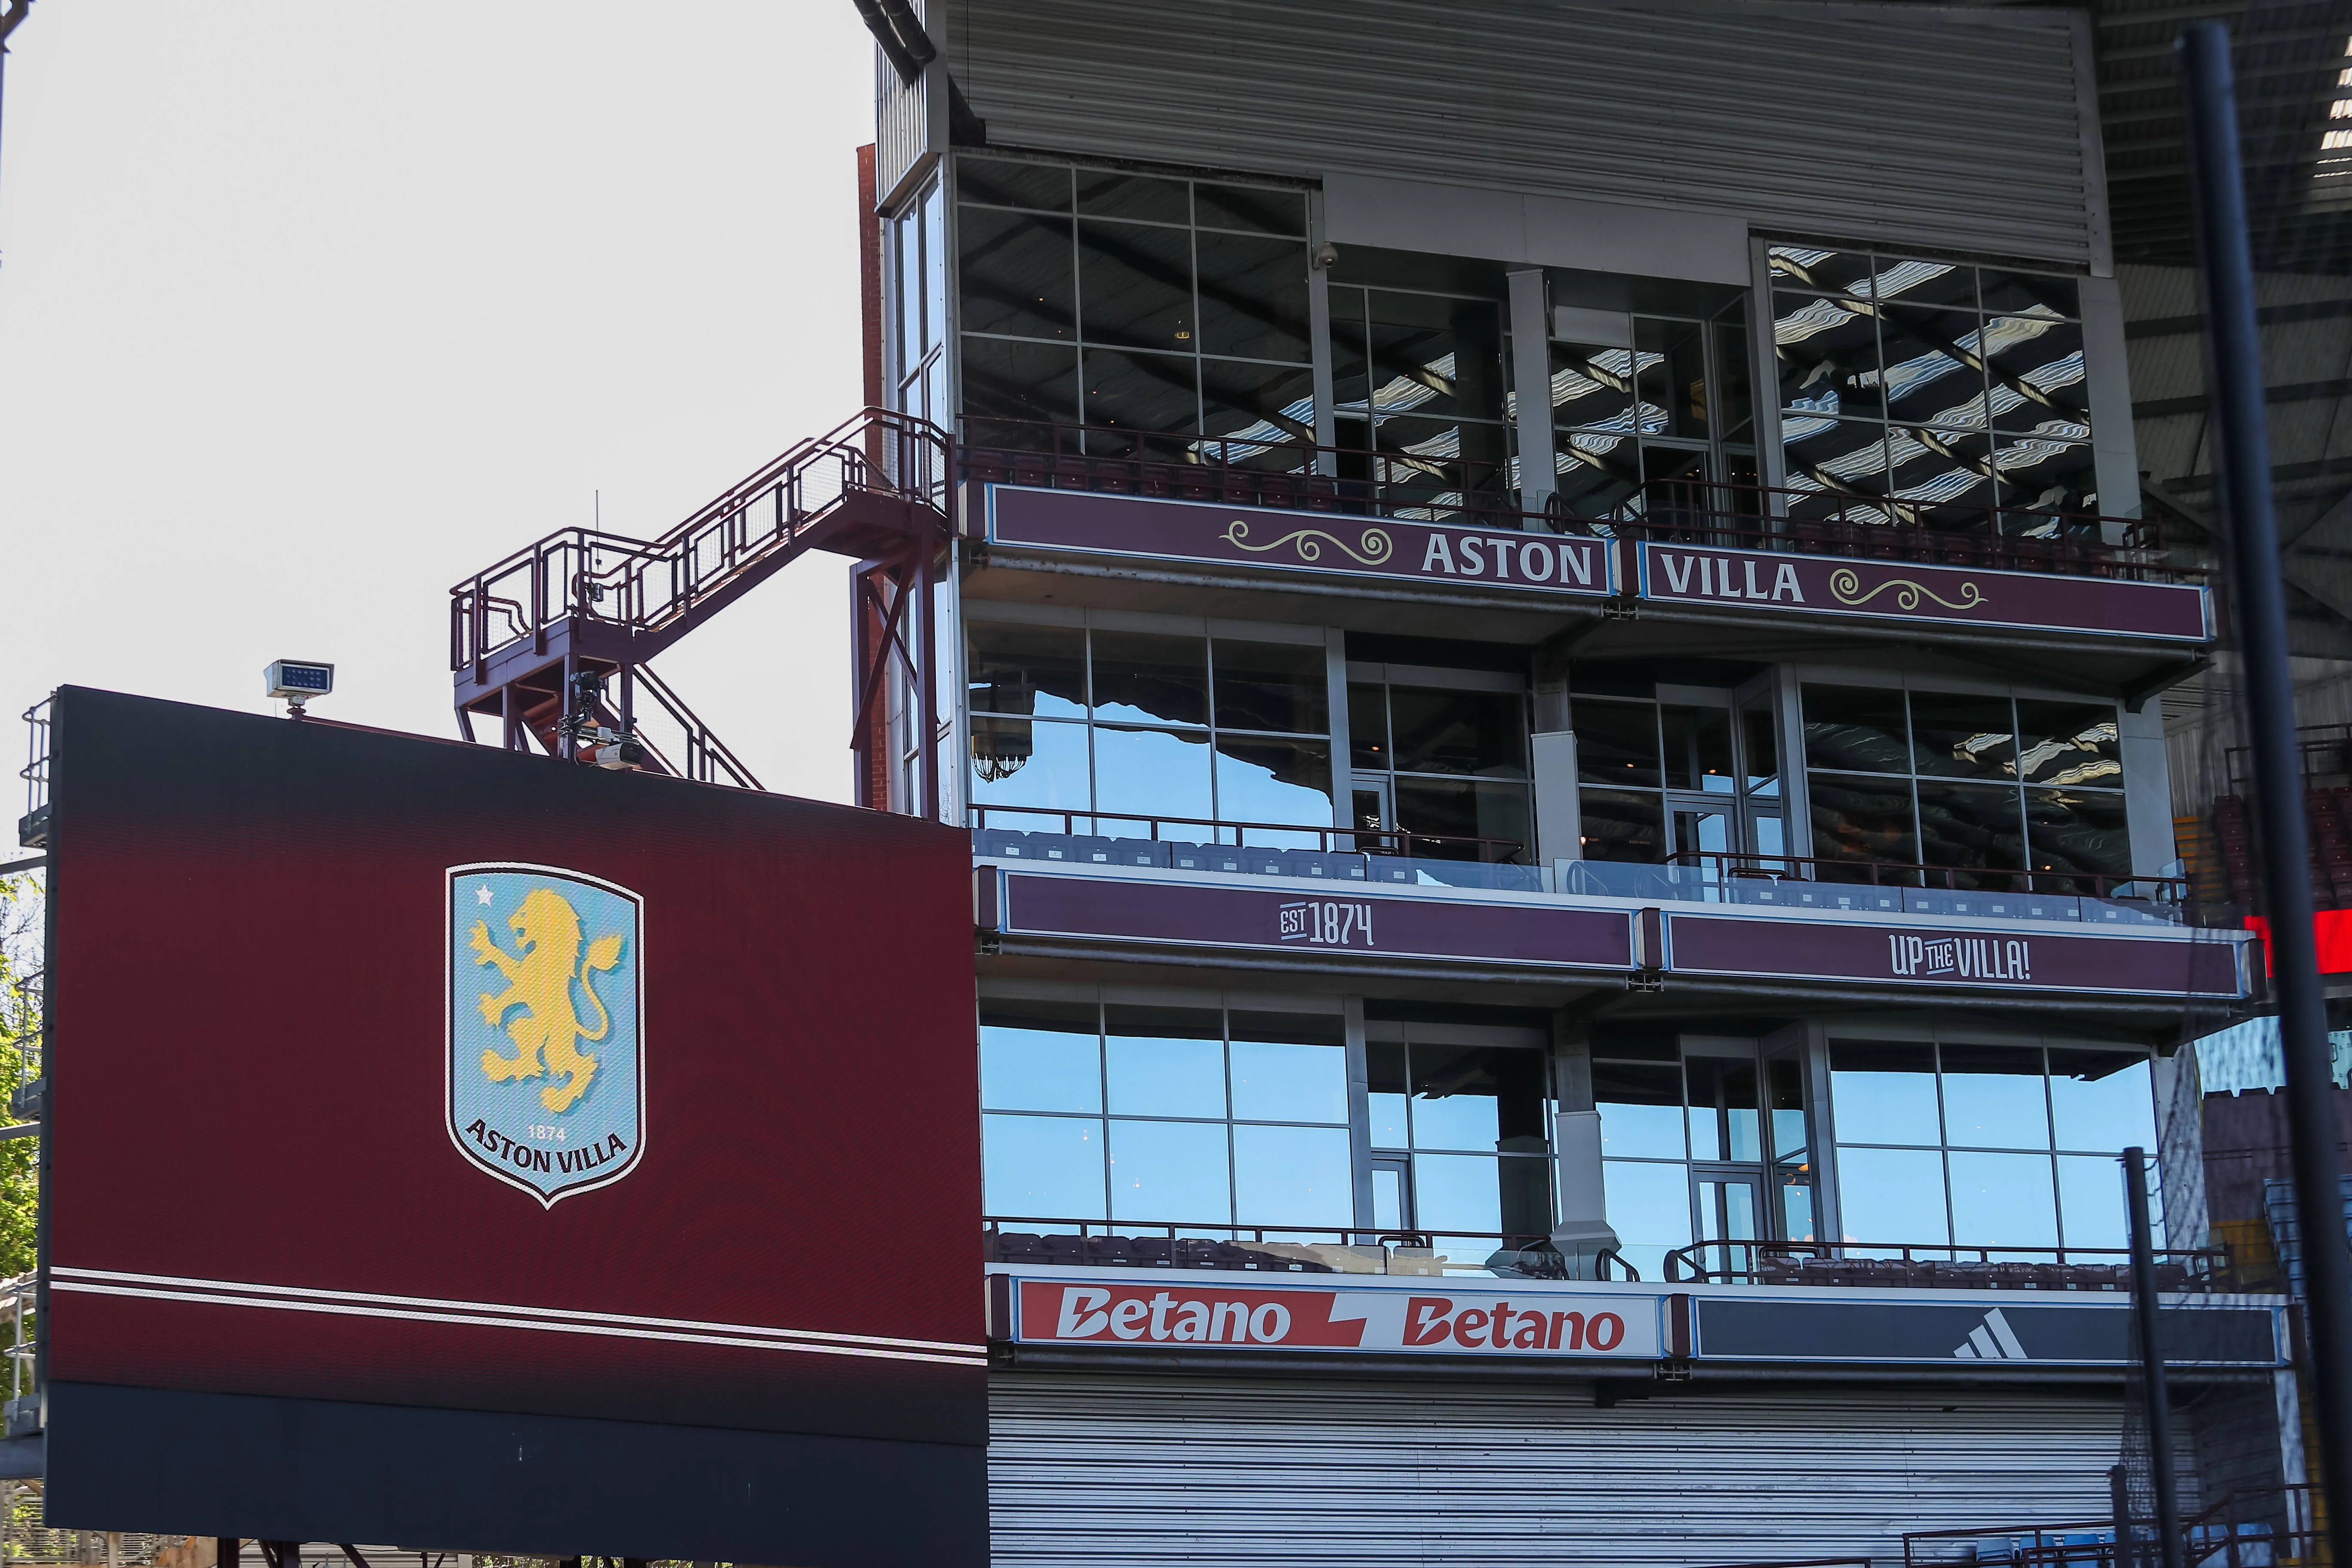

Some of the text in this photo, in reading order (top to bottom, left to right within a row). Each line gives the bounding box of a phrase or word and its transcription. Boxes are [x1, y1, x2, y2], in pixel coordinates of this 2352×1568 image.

[1421, 533, 1805, 603] ASTON VILLA
[1280, 902, 1375, 946] EST 1874
[1888, 934, 2030, 980] UP THE VILLA!
[465, 1118, 628, 1173] ASTON VILLA
[528, 1124, 566, 1141] 1874
[1056, 1287, 1291, 1343] Betano
[1402, 1297, 1625, 1351] Betano
